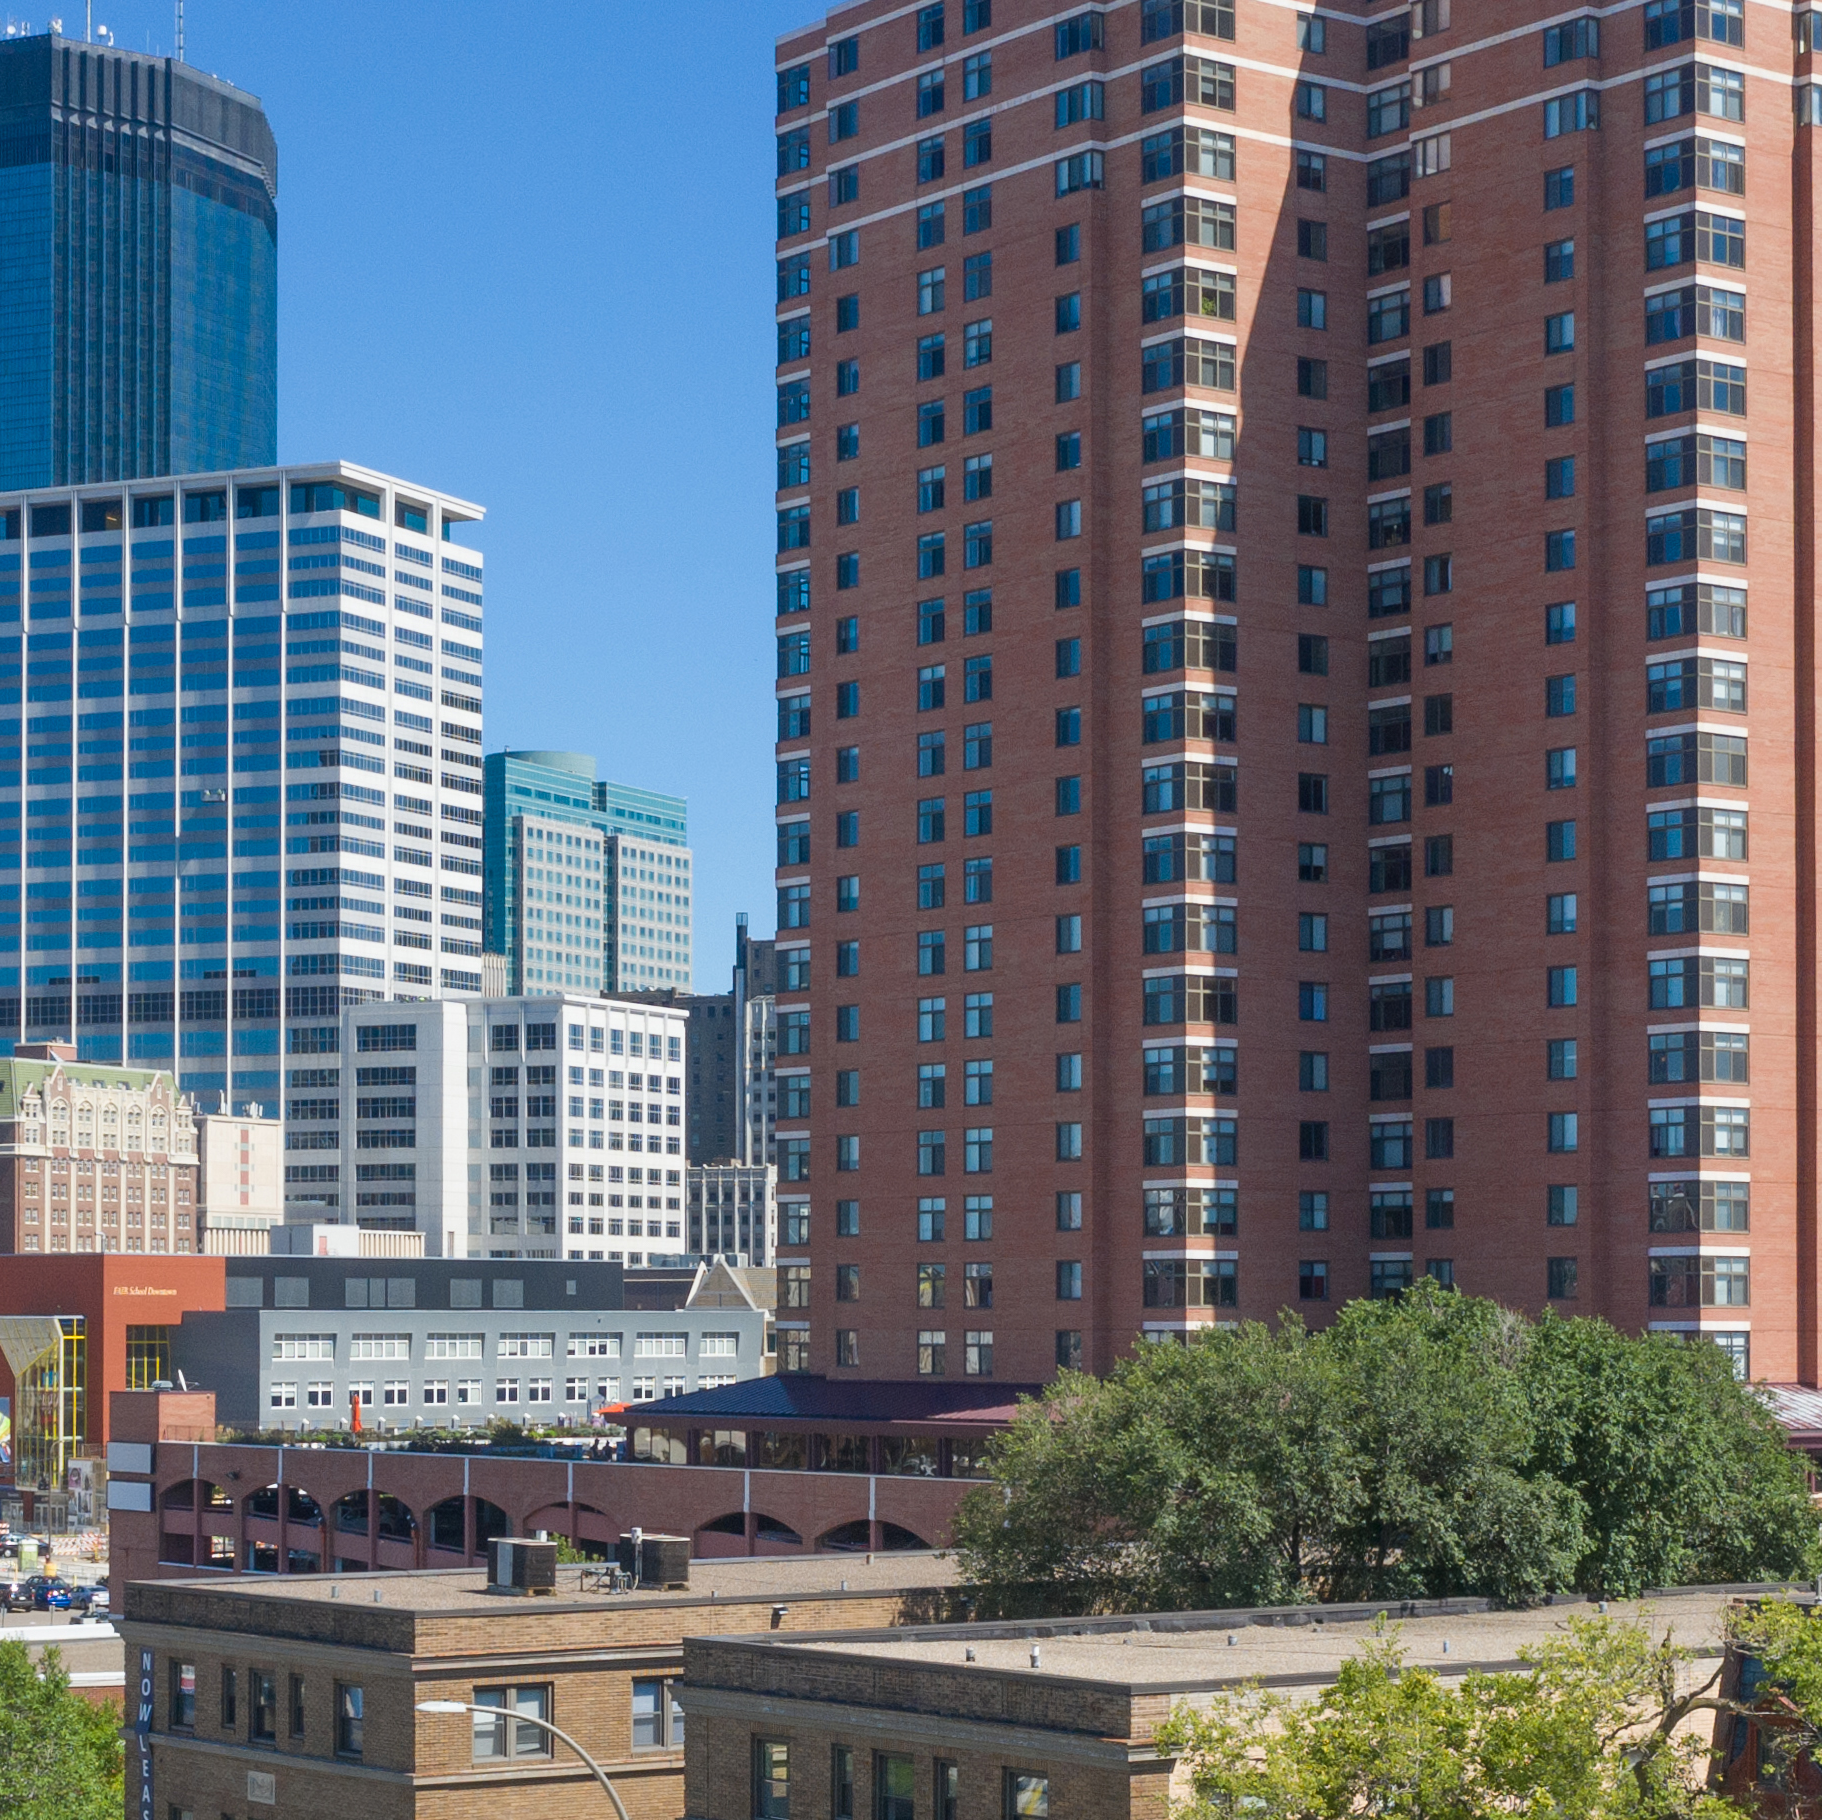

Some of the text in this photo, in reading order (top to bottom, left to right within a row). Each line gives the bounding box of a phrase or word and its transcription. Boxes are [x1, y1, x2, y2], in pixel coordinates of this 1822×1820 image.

[129, 1286, 147, 1295] School
[147, 1286, 178, 1296] Downtown
[139, 1652, 153, 1722] NOW
